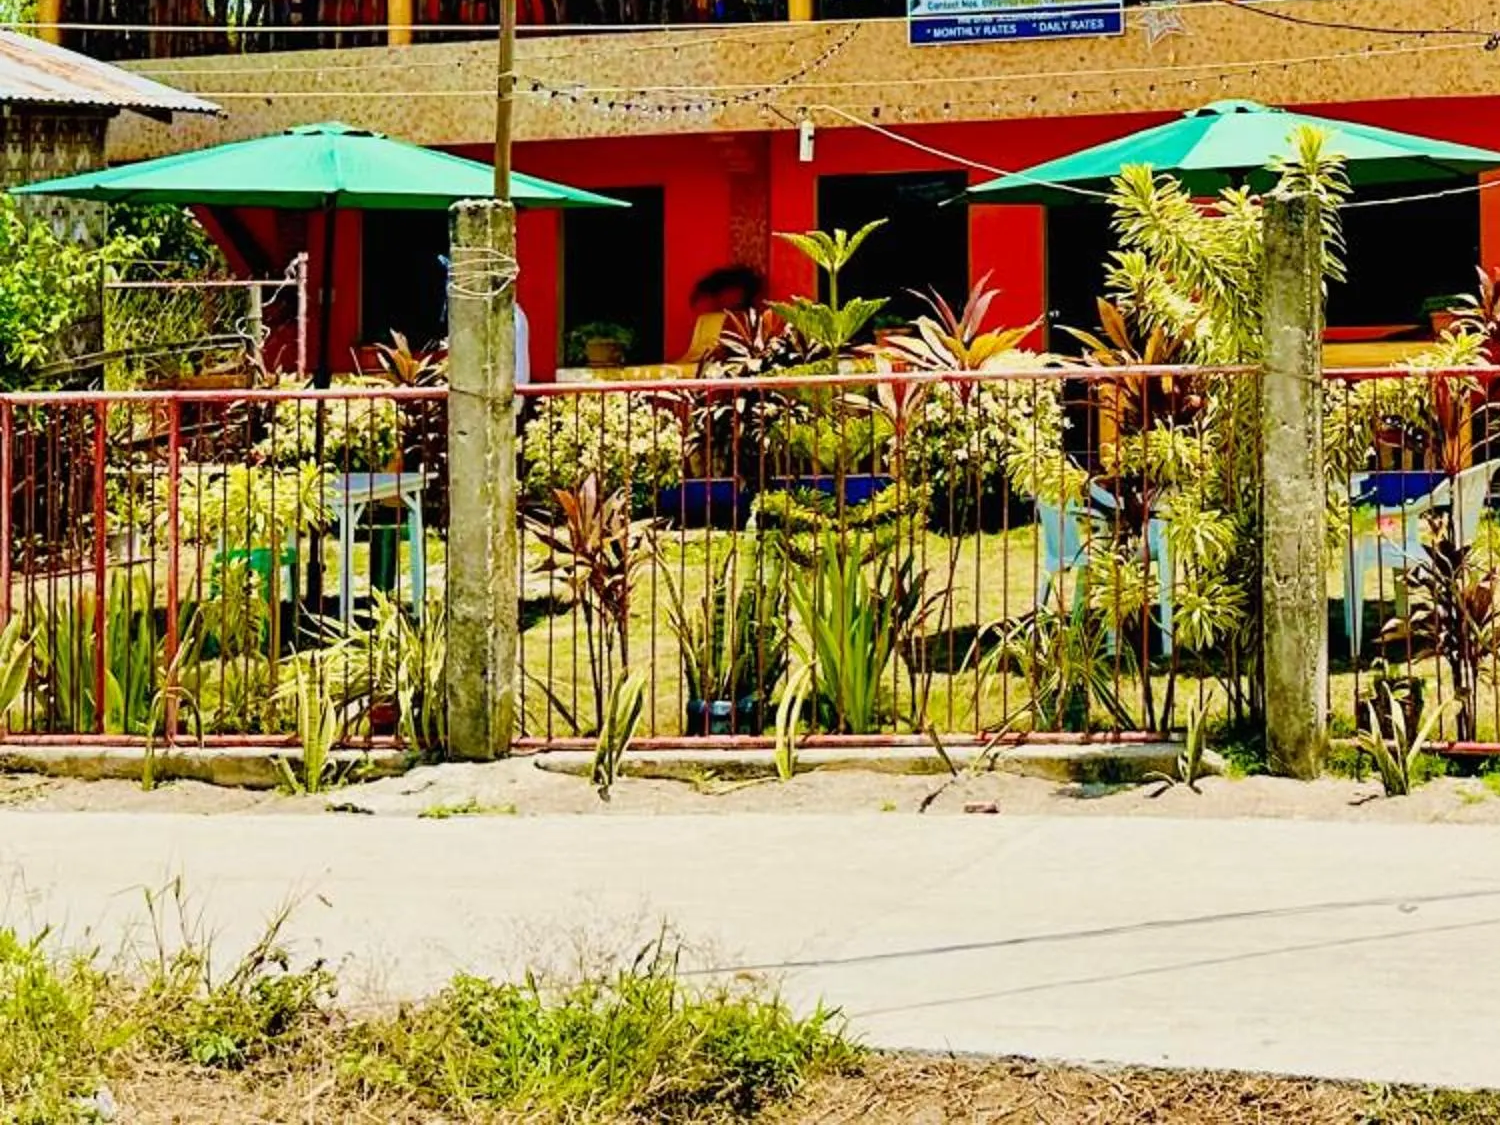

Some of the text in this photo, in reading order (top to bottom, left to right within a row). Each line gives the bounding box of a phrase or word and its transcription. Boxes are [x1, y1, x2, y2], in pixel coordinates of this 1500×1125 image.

[933, 23, 1018, 38] MONTHLY RATES
[1039, 21, 1069, 33] DAILY
[1070, 18, 1105, 30] RATES
